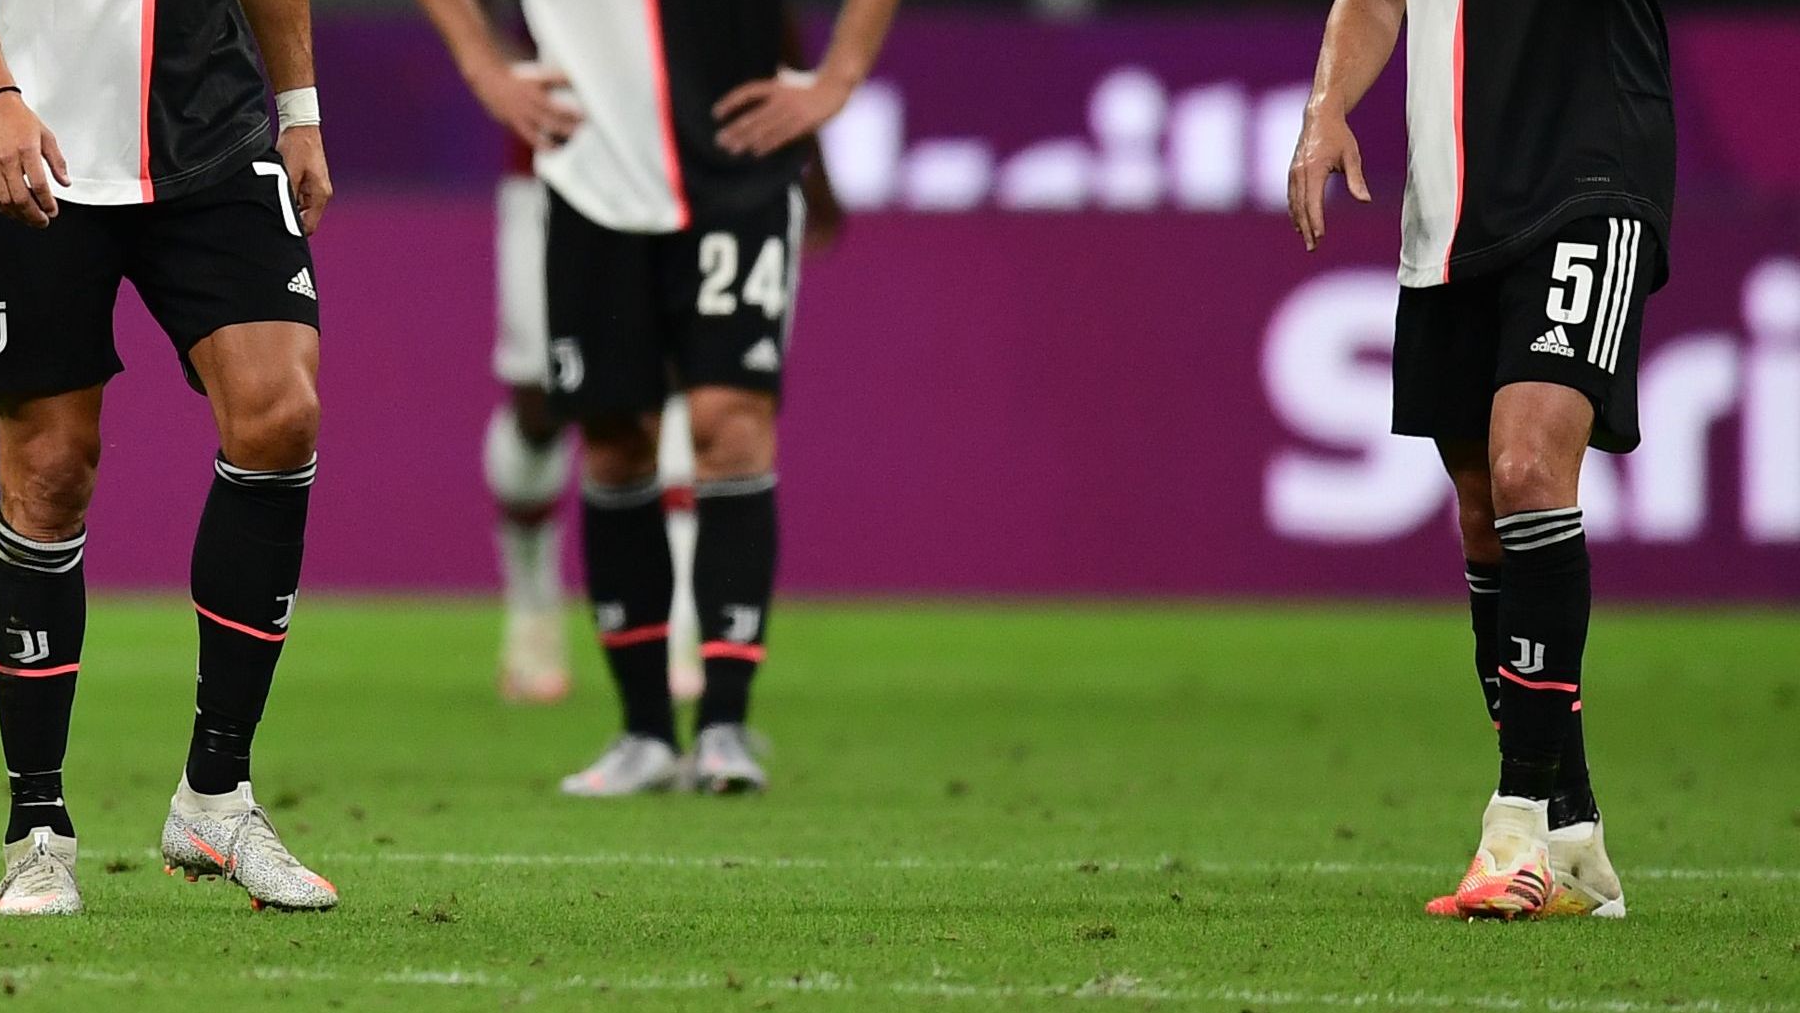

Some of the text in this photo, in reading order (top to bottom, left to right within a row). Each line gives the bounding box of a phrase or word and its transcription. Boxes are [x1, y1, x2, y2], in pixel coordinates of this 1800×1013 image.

[252, 161, 302, 236] 7
[696, 230, 788, 320] 24
[1546, 241, 1598, 324] 5
[1530, 339, 1575, 358] adidas
